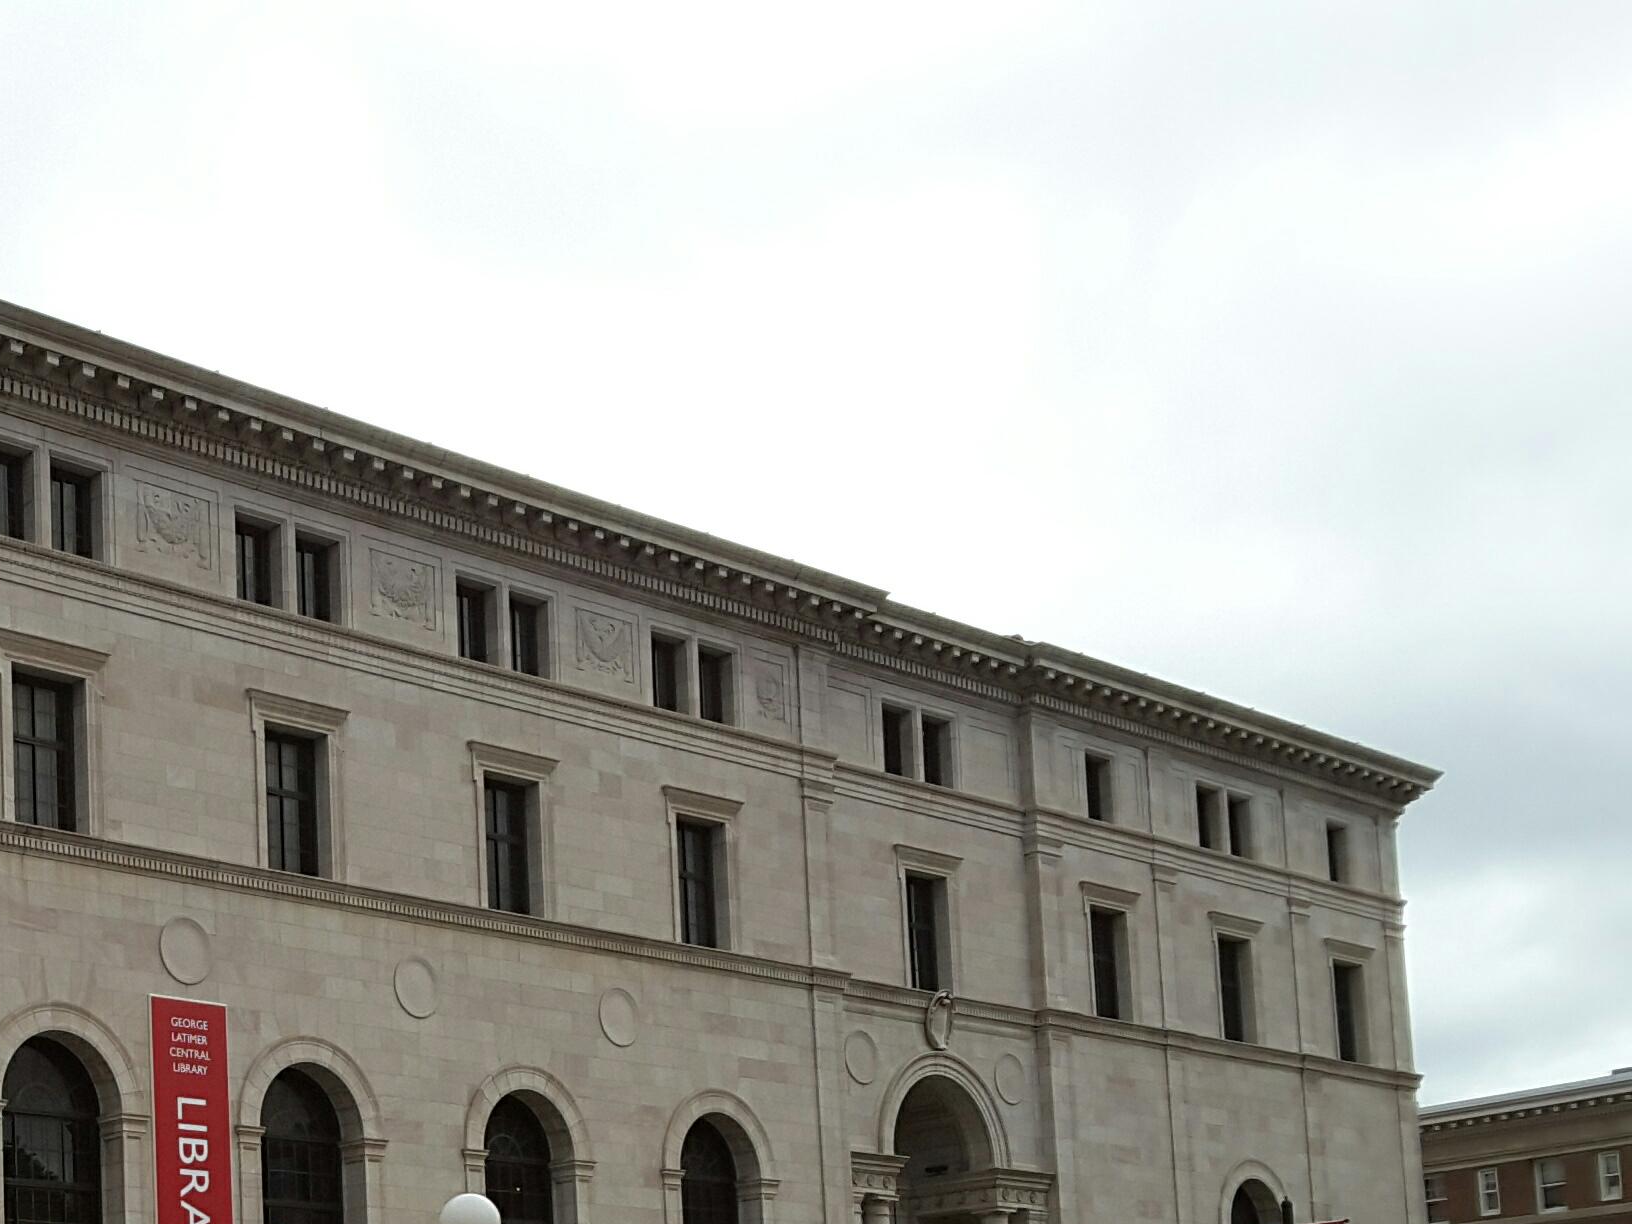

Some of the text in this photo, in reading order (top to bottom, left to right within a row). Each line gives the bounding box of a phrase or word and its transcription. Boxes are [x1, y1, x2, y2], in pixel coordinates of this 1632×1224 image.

[170, 1016, 209, 1031] GEORGE
[171, 1031, 208, 1046] LATIMER
[169, 1046, 211, 1061] CENTRAL
[172, 1061, 208, 1076] LIBRARY
